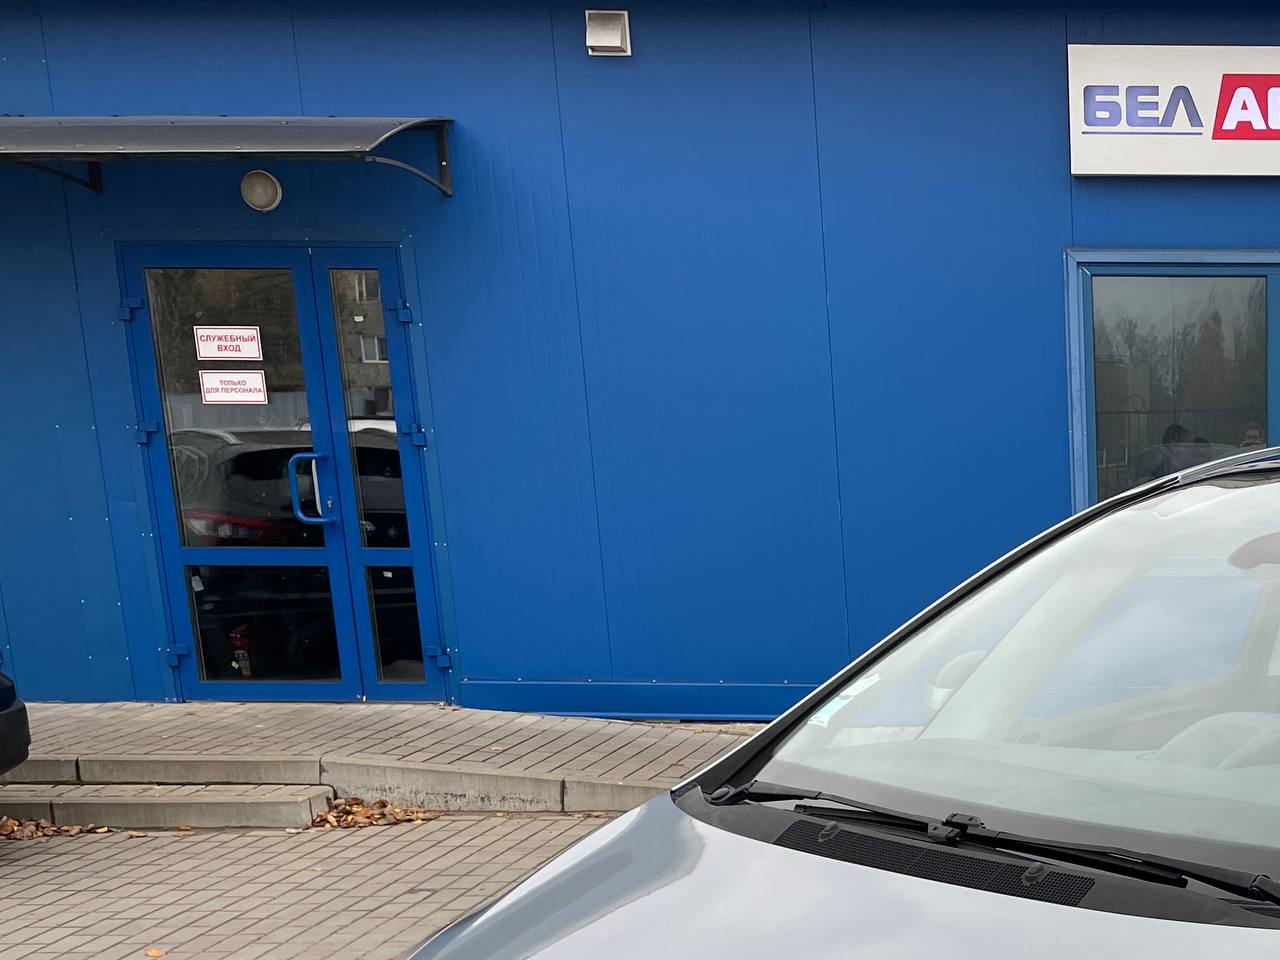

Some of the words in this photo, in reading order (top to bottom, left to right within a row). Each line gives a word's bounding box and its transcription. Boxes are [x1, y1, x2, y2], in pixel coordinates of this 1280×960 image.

[1083, 85, 1204, 128] БЕЛ
[199, 333, 256, 343] СЛУЖЕБНЫЙ
[217, 344, 241, 352] ВХОД
